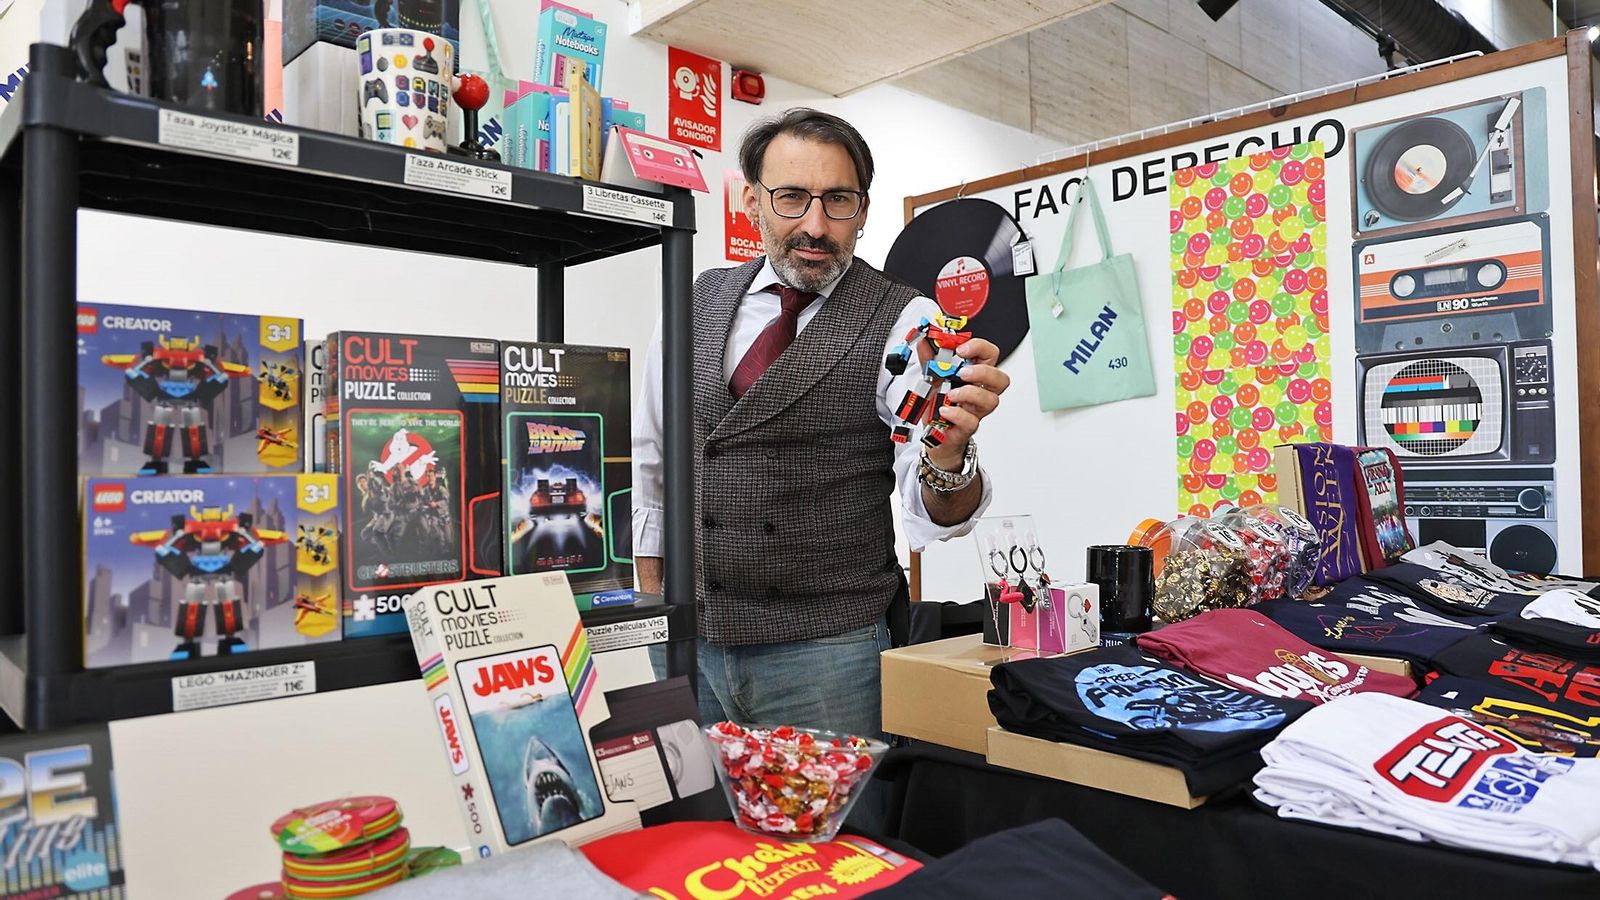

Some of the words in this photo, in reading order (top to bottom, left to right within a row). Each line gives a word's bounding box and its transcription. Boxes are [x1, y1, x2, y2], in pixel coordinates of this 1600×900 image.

[555, 34, 600, 57] Notebooks
[167, 112, 195, 127] Taza
[199, 120, 248, 136] Joystick
[252, 128, 294, 144] Mágica
[673, 117, 716, 135] AVISADOR
[676, 127, 714, 144] SONORO
[272, 147, 292, 160] 12€
[410, 155, 434, 168] Taza
[437, 161, 473, 176] Arcade
[475, 168, 498, 180] Stick
[491, 185, 507, 196] 12€
[587, 186, 593, 195] 3
[595, 188, 629, 202] Libretas
[630, 195, 665, 209] Cassette
[652, 212, 666, 222] 14€
[730, 236, 756, 249] BOCA
[1365, 254, 1374, 264] A
[937, 278, 959, 289] VINYL
[960, 271, 987, 285] RECORD
[1438, 301, 1451, 310] LN
[1452, 298, 1469, 309] 90
[102, 315, 172, 332] CREATOR
[1063, 305, 1118, 375] MILAN
[344, 335, 419, 365] CULT
[504, 345, 566, 373] CULT
[1108, 357, 1128, 370] 430
[345, 365, 409, 382] MOVIES
[505, 371, 558, 388] MOVIES
[345, 381, 396, 400] PUZZLE
[396, 391, 432, 401] COLLECTION
[505, 387, 548, 404] PUZZLE
[547, 396, 577, 405] COLLECTION
[526, 422, 580, 441] BACK
[130, 489, 205, 505] CREATOR
[434, 584, 497, 615] CULT
[441, 612, 498, 632] MOVIES
[586, 627, 613, 638] Puzzle
[613, 621, 647, 633] Películas
[648, 617, 664, 627] VHS
[445, 628, 492, 651] PUZZLE
[652, 629, 668, 641] 10€
[178, 674, 215, 689] LEGO
[473, 655, 555, 697] JAWS
[1095, 671, 1142, 686] STREET
[284, 680, 304, 692] 11€
[439, 706, 465, 765] JAWS
[466, 802, 482, 835] 500
